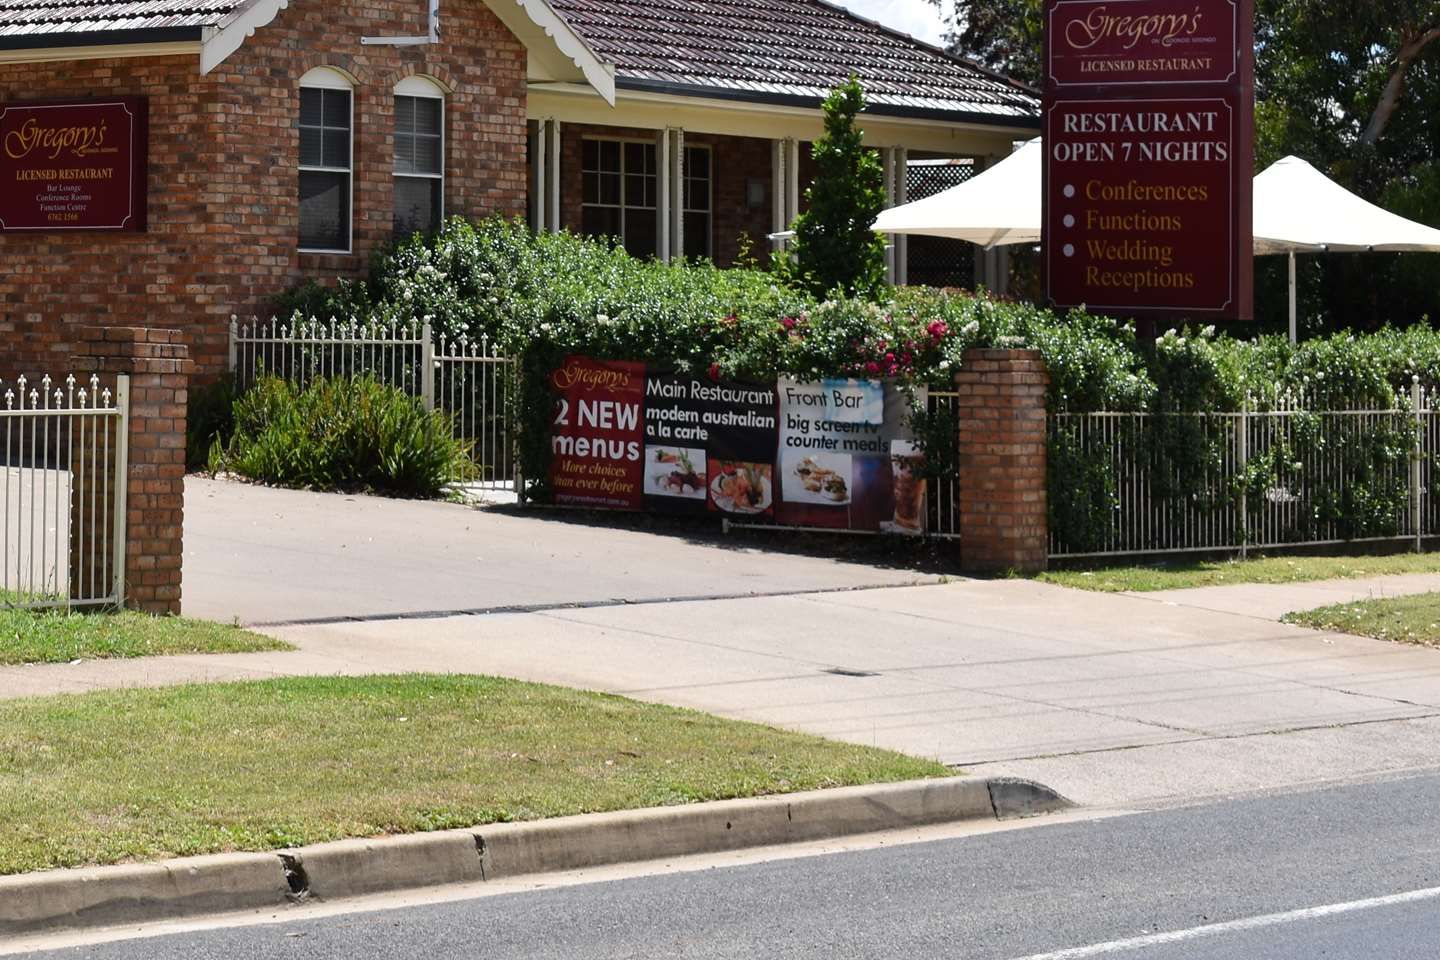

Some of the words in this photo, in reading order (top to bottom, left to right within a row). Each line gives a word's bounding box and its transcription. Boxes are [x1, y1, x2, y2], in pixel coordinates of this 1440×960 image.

[1065, 6, 1203, 50] Gregory's
[1080, 60, 1135, 72] LICENSED
[1137, 58, 1213, 71] RESTAURANT
[1063, 111, 1218, 133] RESTAURANT
[5, 118, 108, 159] Gregory's
[1053, 142, 1115, 163] OPEN
[1122, 142, 1132, 162] 7
[1139, 141, 1228, 162] NIGHTS
[16, 170, 57, 181] LICENSED
[59, 168, 113, 180] RESTAURANT
[1086, 180, 1208, 202] Conferences
[1086, 210, 1182, 231] Functions
[1087, 240, 1173, 266] Wedding
[1086, 267, 1194, 292] Receptions
[646, 378, 686, 398] Main
[690, 380, 774, 405] Restaurant
[786, 387, 828, 407] Front
[832, 389, 864, 408] Bar
[553, 398, 569, 425] 2
[577, 399, 639, 431] NEW
[646, 405, 699, 423] modern
[702, 410, 775, 428] australian
[787, 413, 810, 434] big
[814, 420, 860, 433] screen
[864, 420, 880, 433] tv
[646, 424, 655, 436] a
[658, 421, 671, 437] la
[674, 425, 709, 440] carte
[551, 434, 640, 461] menus
[786, 435, 840, 449] counter
[843, 436, 889, 452] meals
[561, 459, 587, 473] More
[588, 462, 627, 476] choices
[575, 479, 600, 489] ever
[600, 477, 634, 495] before
